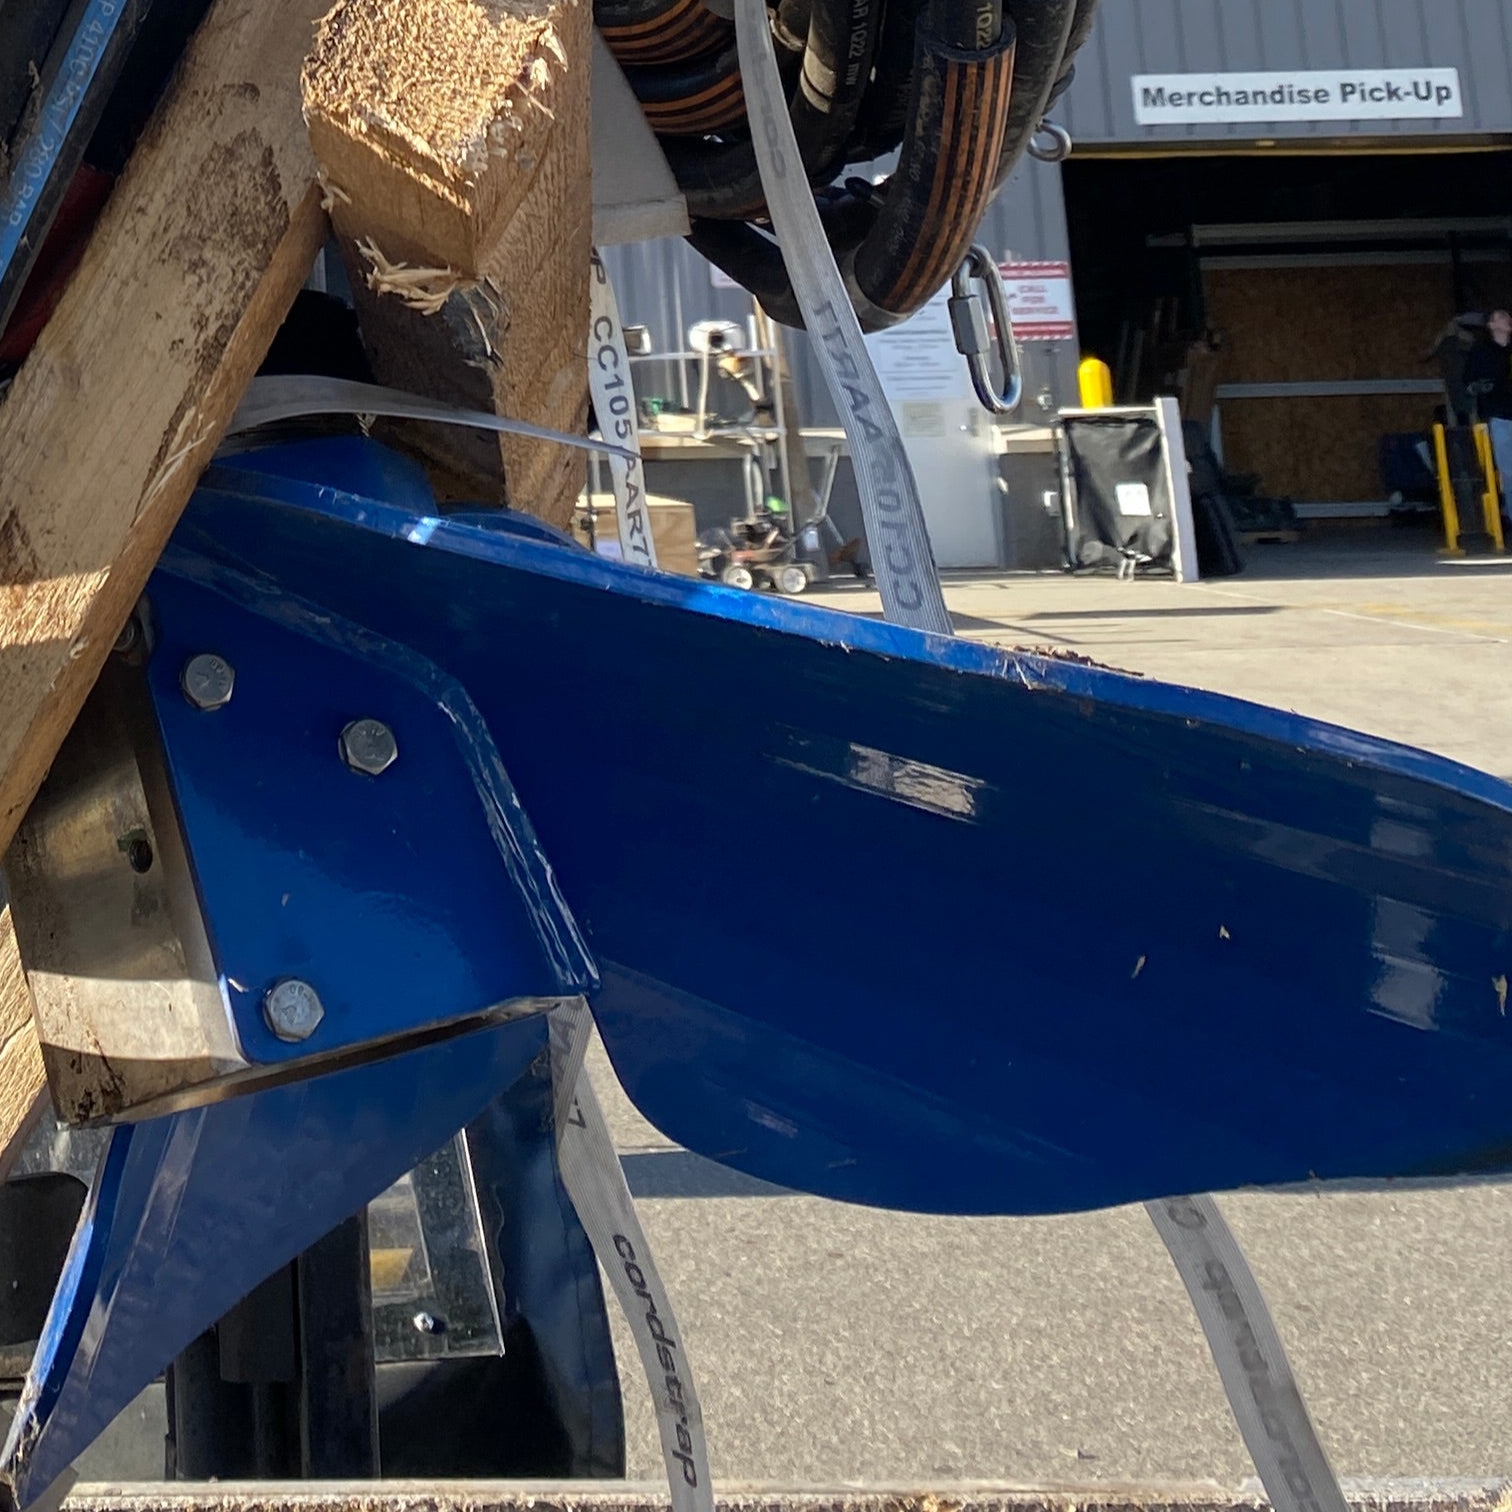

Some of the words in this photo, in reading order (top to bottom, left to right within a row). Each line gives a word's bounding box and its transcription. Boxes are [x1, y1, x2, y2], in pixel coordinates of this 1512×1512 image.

[1140, 83, 1331, 109] Merchandise
[1339, 79, 1453, 107] Pick-Up
[593, 315, 633, 439] CC105
[611, 1233, 698, 1488] cordstrap
